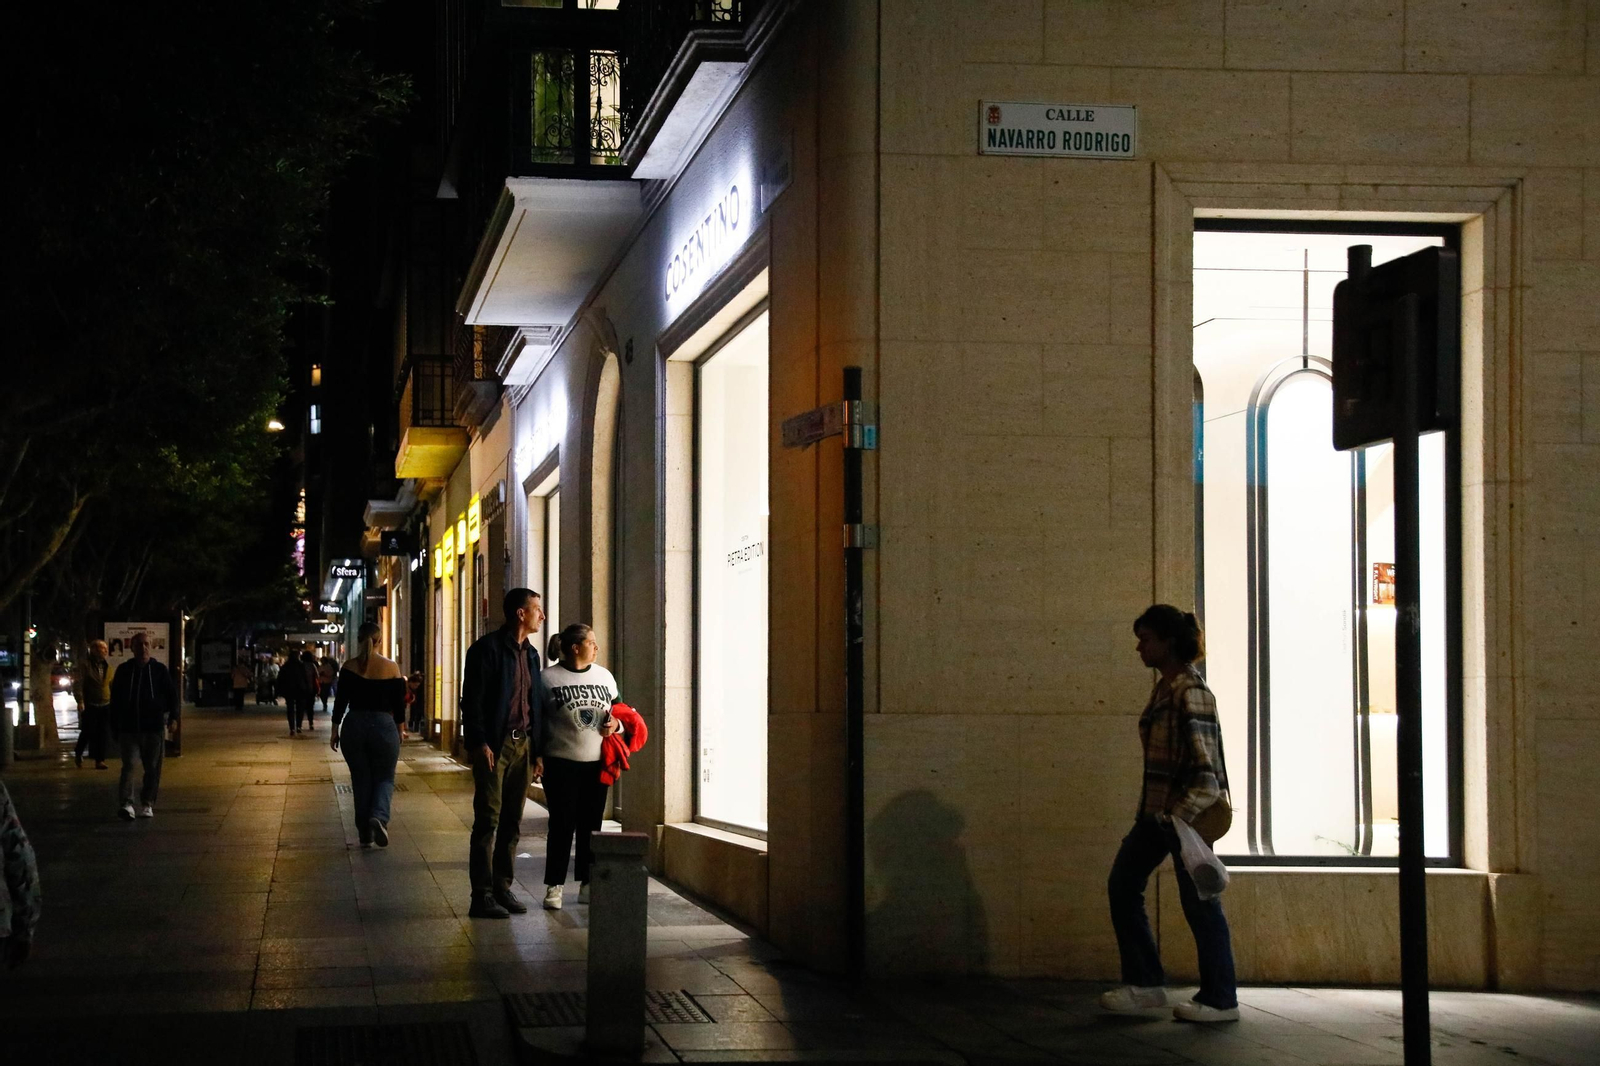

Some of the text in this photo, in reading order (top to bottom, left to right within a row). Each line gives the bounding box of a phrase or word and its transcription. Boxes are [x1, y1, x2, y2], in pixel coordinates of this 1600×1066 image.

[1045, 108, 1095, 122] CALLE
[987, 128, 1131, 153] NAVARRO RODRIGO
[664, 184, 740, 302] COSENTINO
[336, 566, 358, 577] Sfera
[320, 623, 345, 634] JOY
[551, 684, 612, 710] HOUSTON
[566, 699, 606, 711] SPACE CITY
